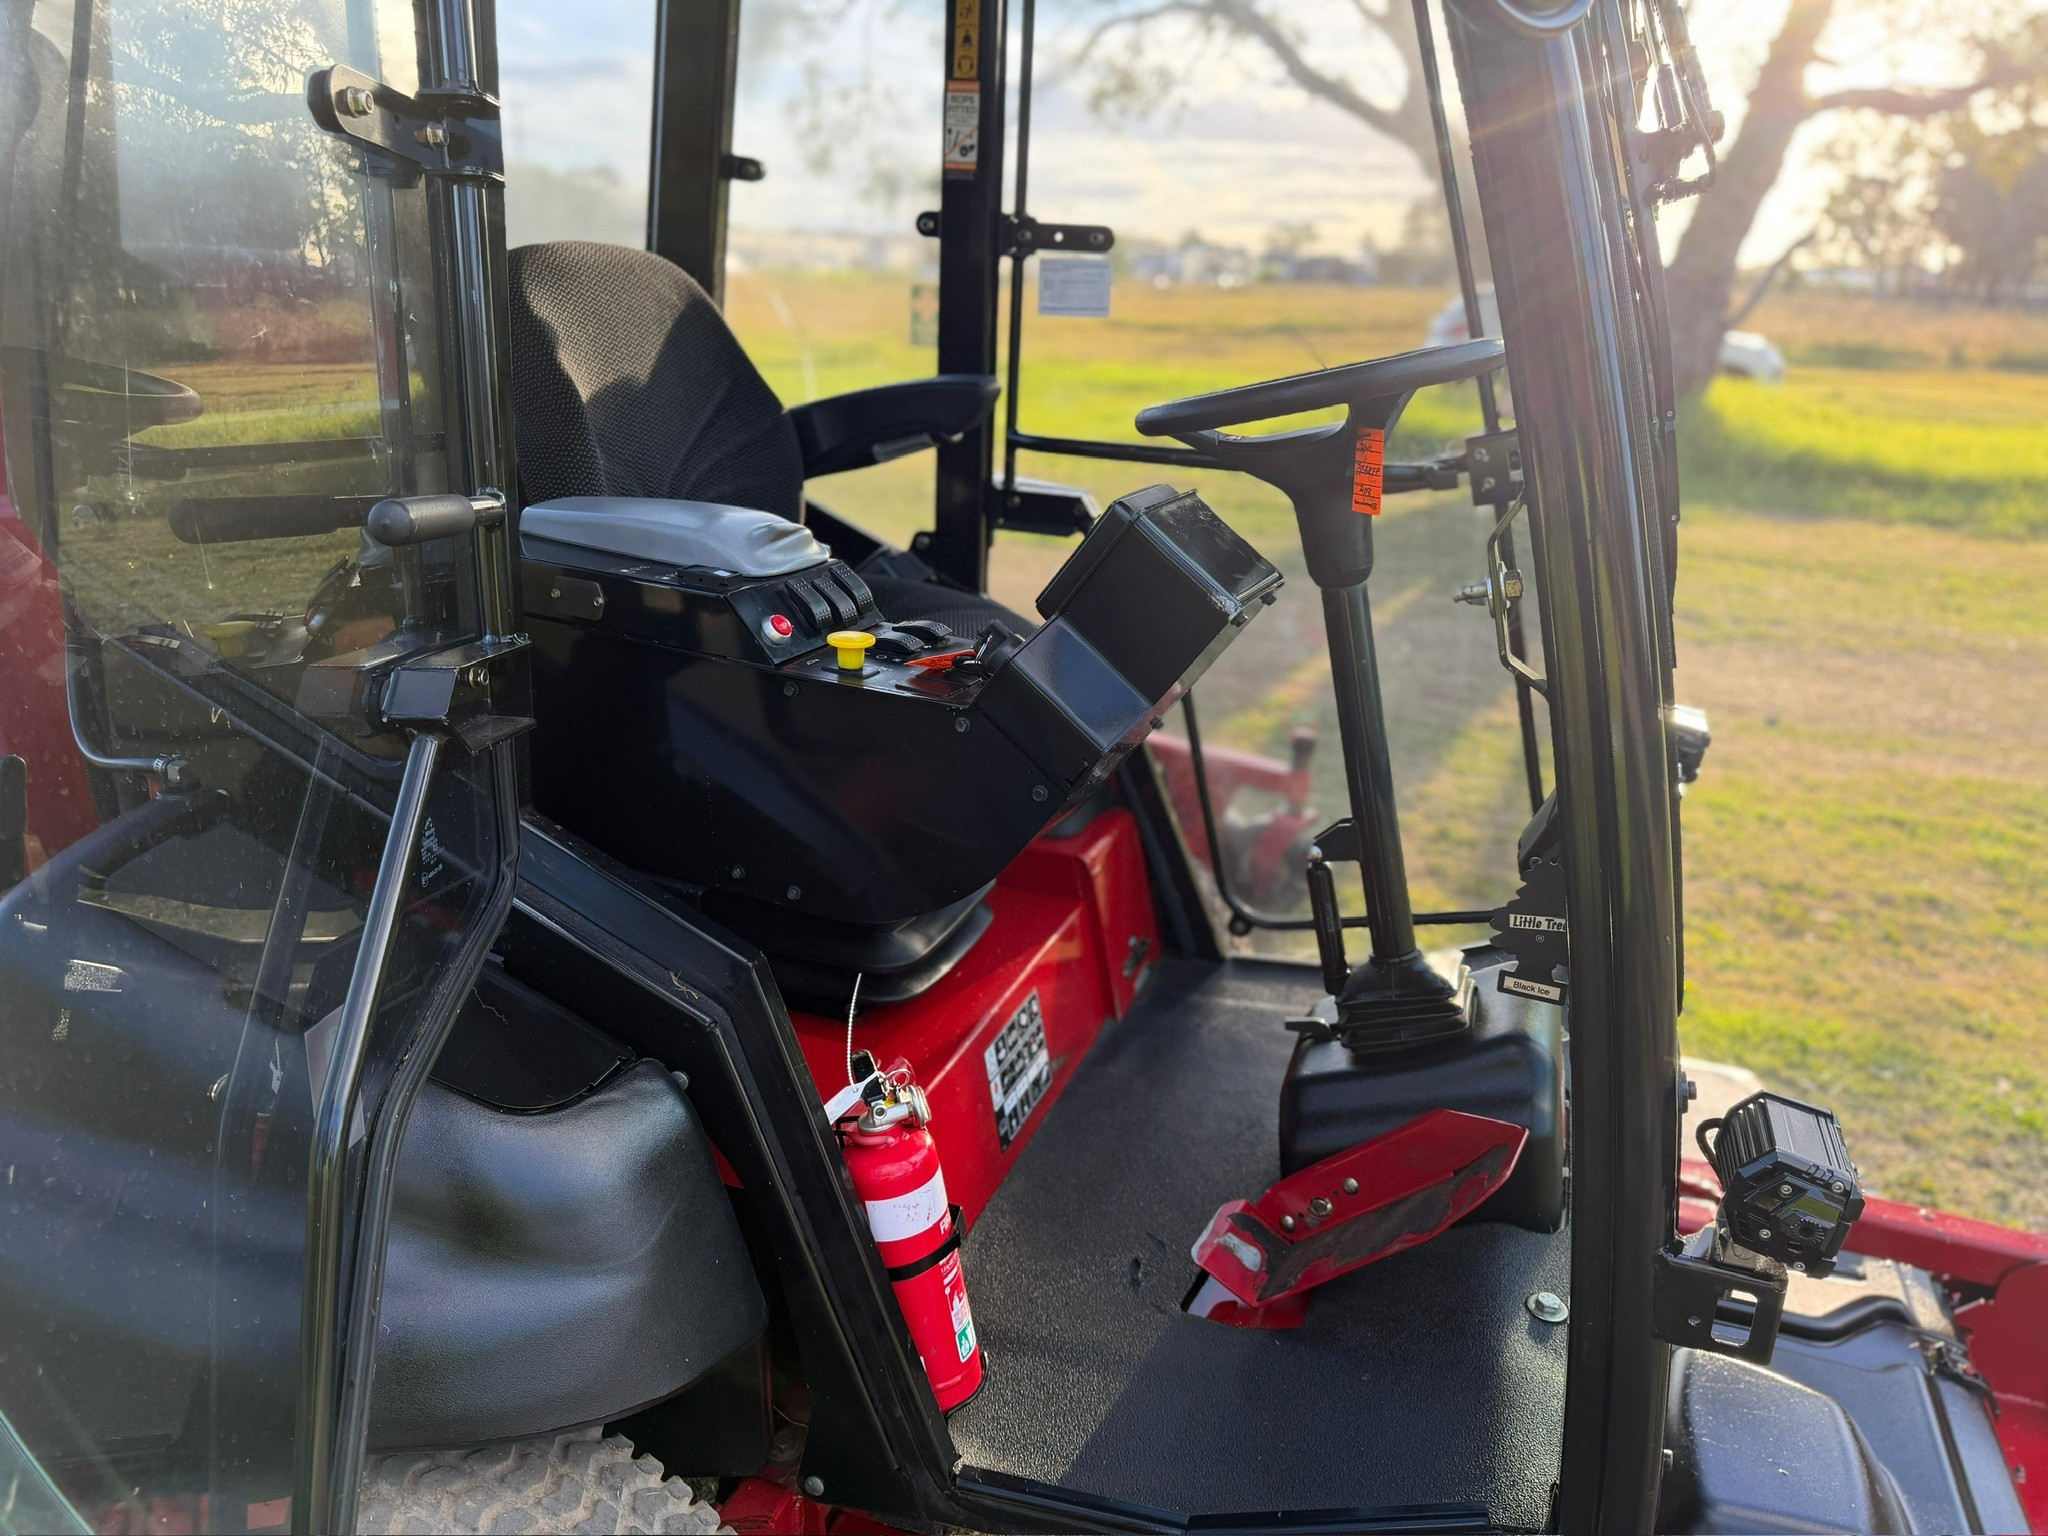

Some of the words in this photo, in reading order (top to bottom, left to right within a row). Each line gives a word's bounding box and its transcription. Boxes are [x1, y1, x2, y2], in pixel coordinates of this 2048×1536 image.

[947, 106, 977, 114] FITTED
[1512, 915, 1542, 929] Little
[1513, 981, 1536, 993] Black
[1537, 986, 1550, 996] Ice
